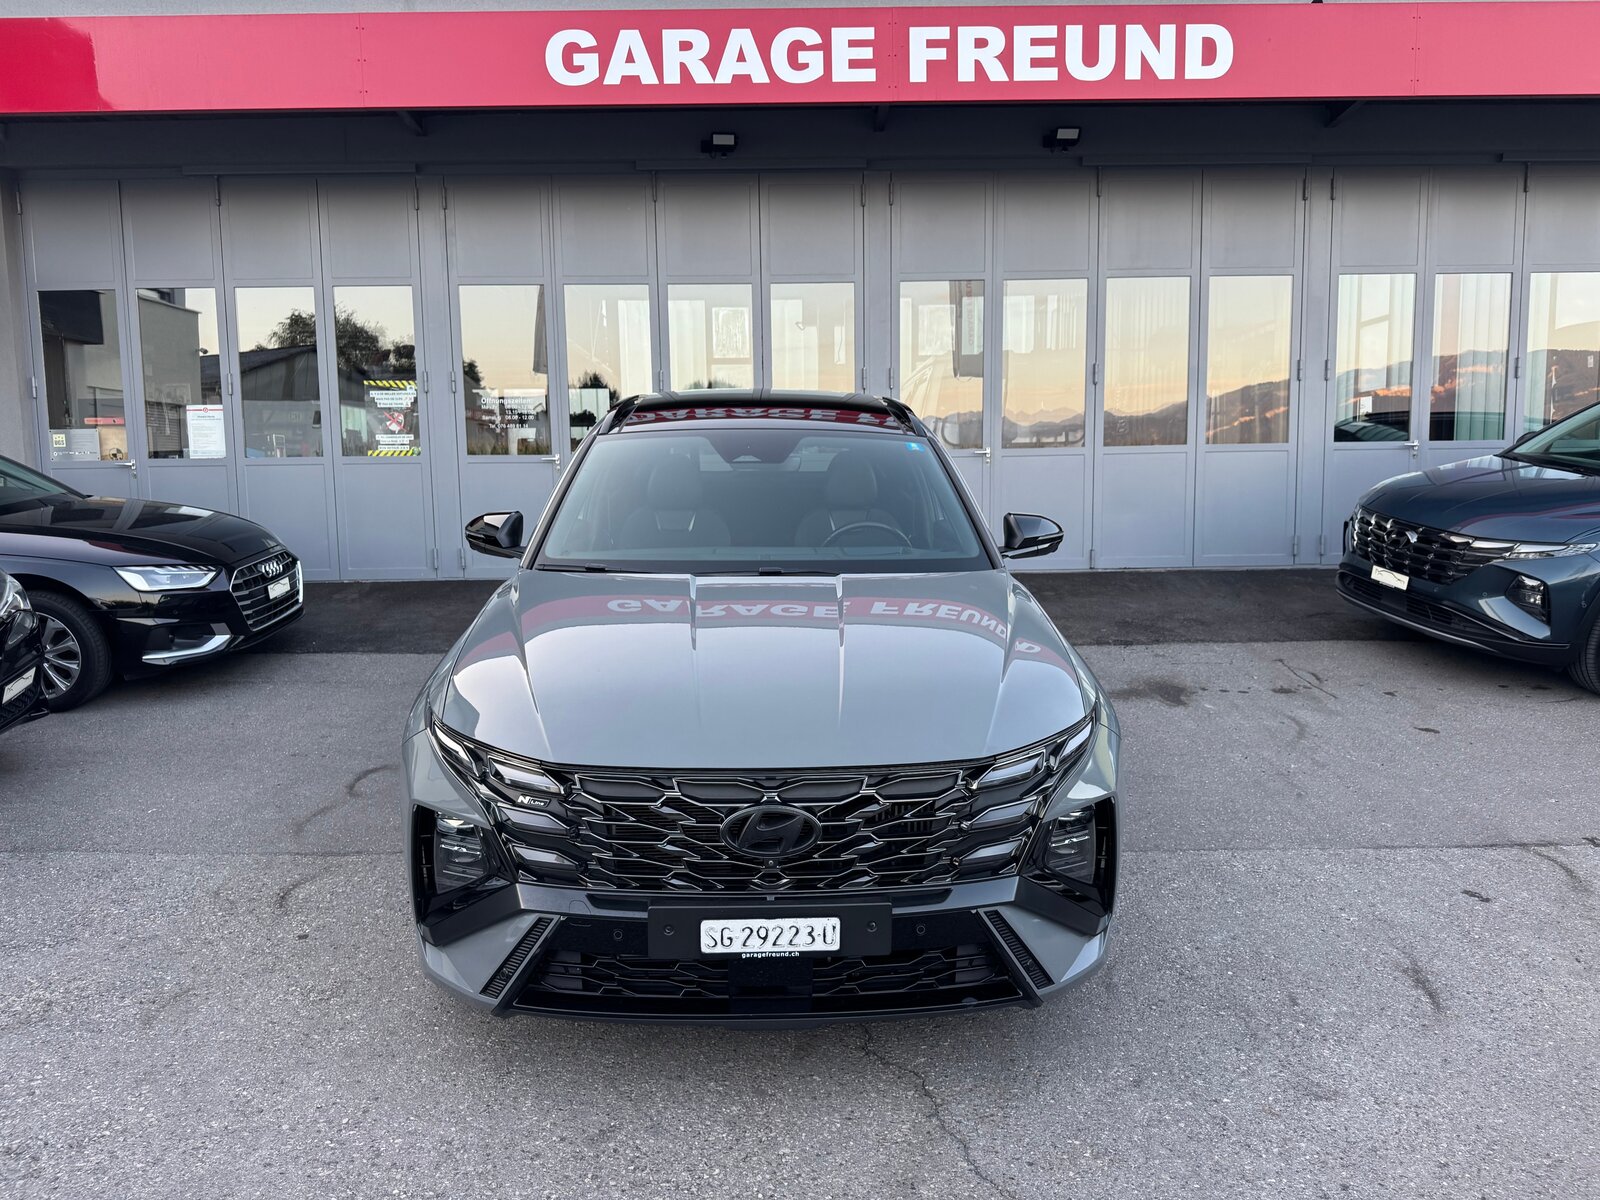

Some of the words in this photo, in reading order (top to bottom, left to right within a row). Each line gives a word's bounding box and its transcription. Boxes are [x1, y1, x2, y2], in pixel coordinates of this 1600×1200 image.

[544, 26, 877, 86] GARAGE
[908, 23, 1234, 83] FREUND
[741, 950, 800, 959] garagefreund.ch
